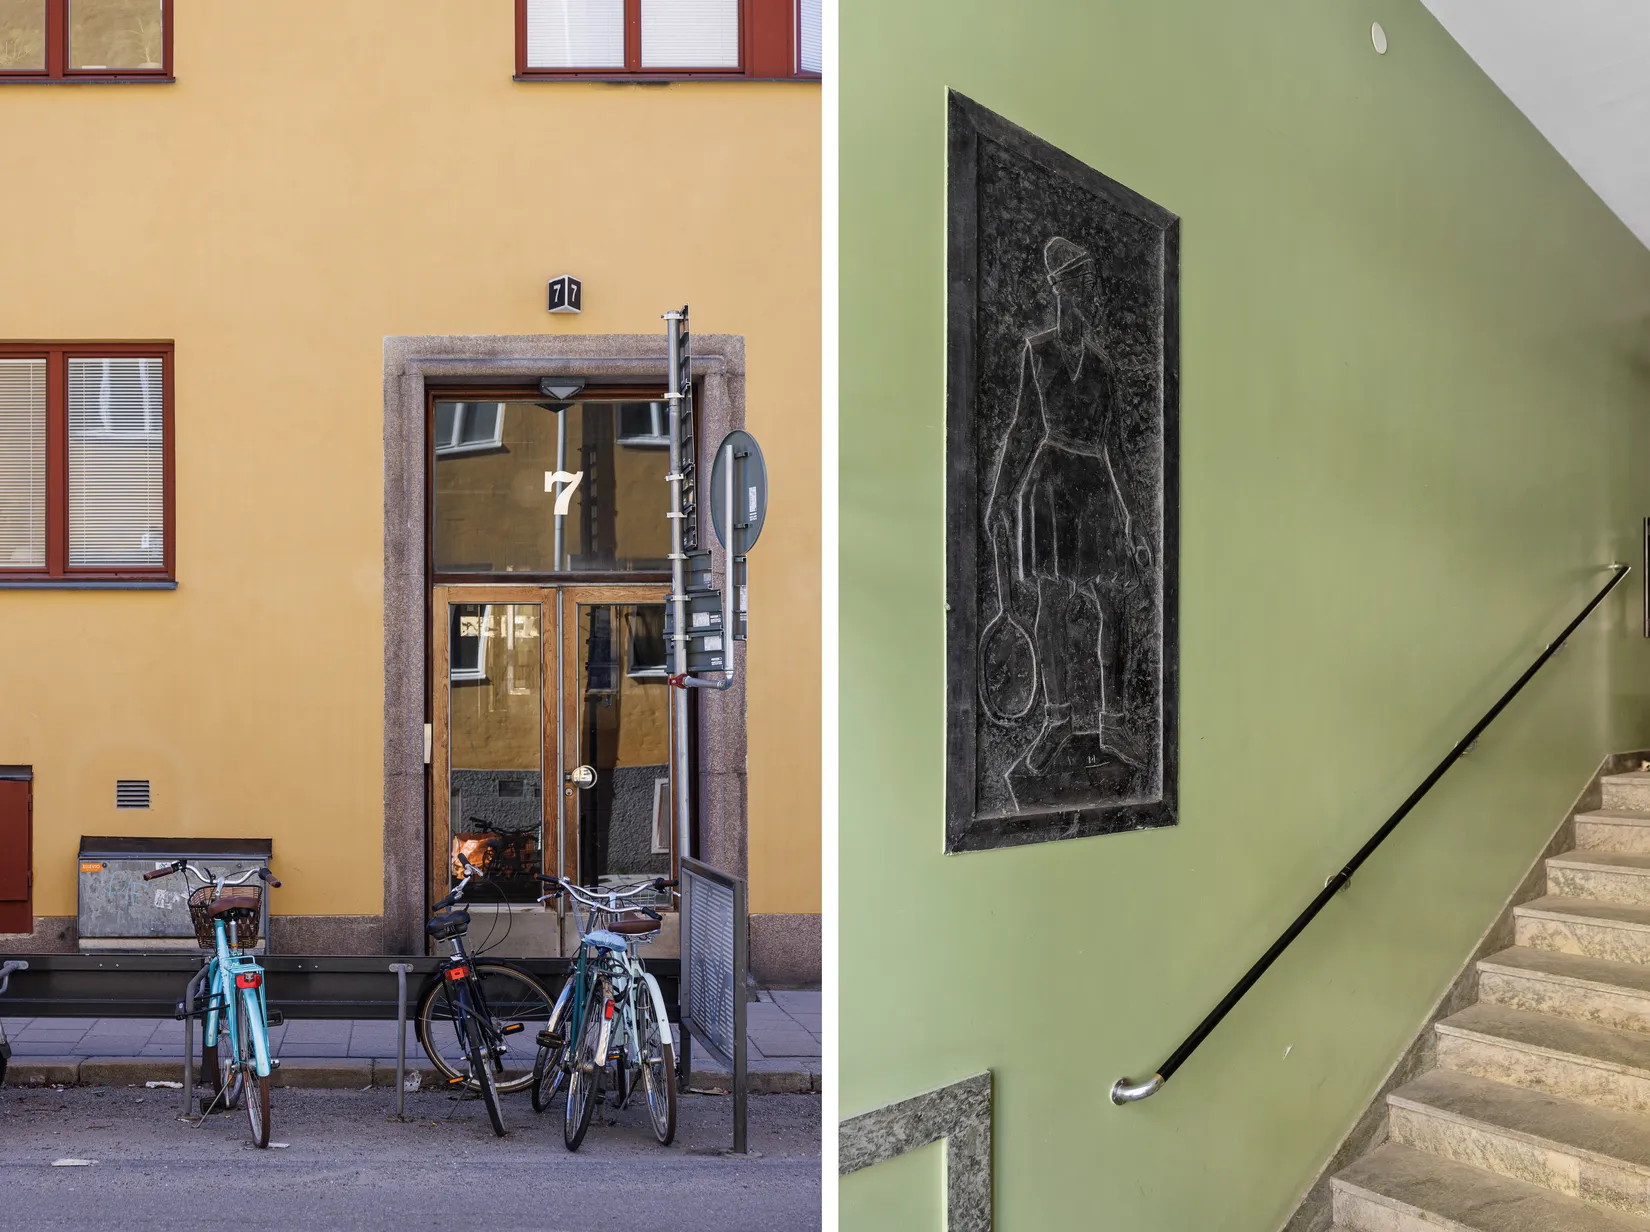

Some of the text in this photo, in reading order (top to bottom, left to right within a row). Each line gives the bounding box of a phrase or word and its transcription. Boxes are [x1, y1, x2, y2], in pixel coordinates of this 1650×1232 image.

[553, 284, 561, 302] 7
[571, 284, 578, 302] 7
[544, 470, 584, 515] 7
